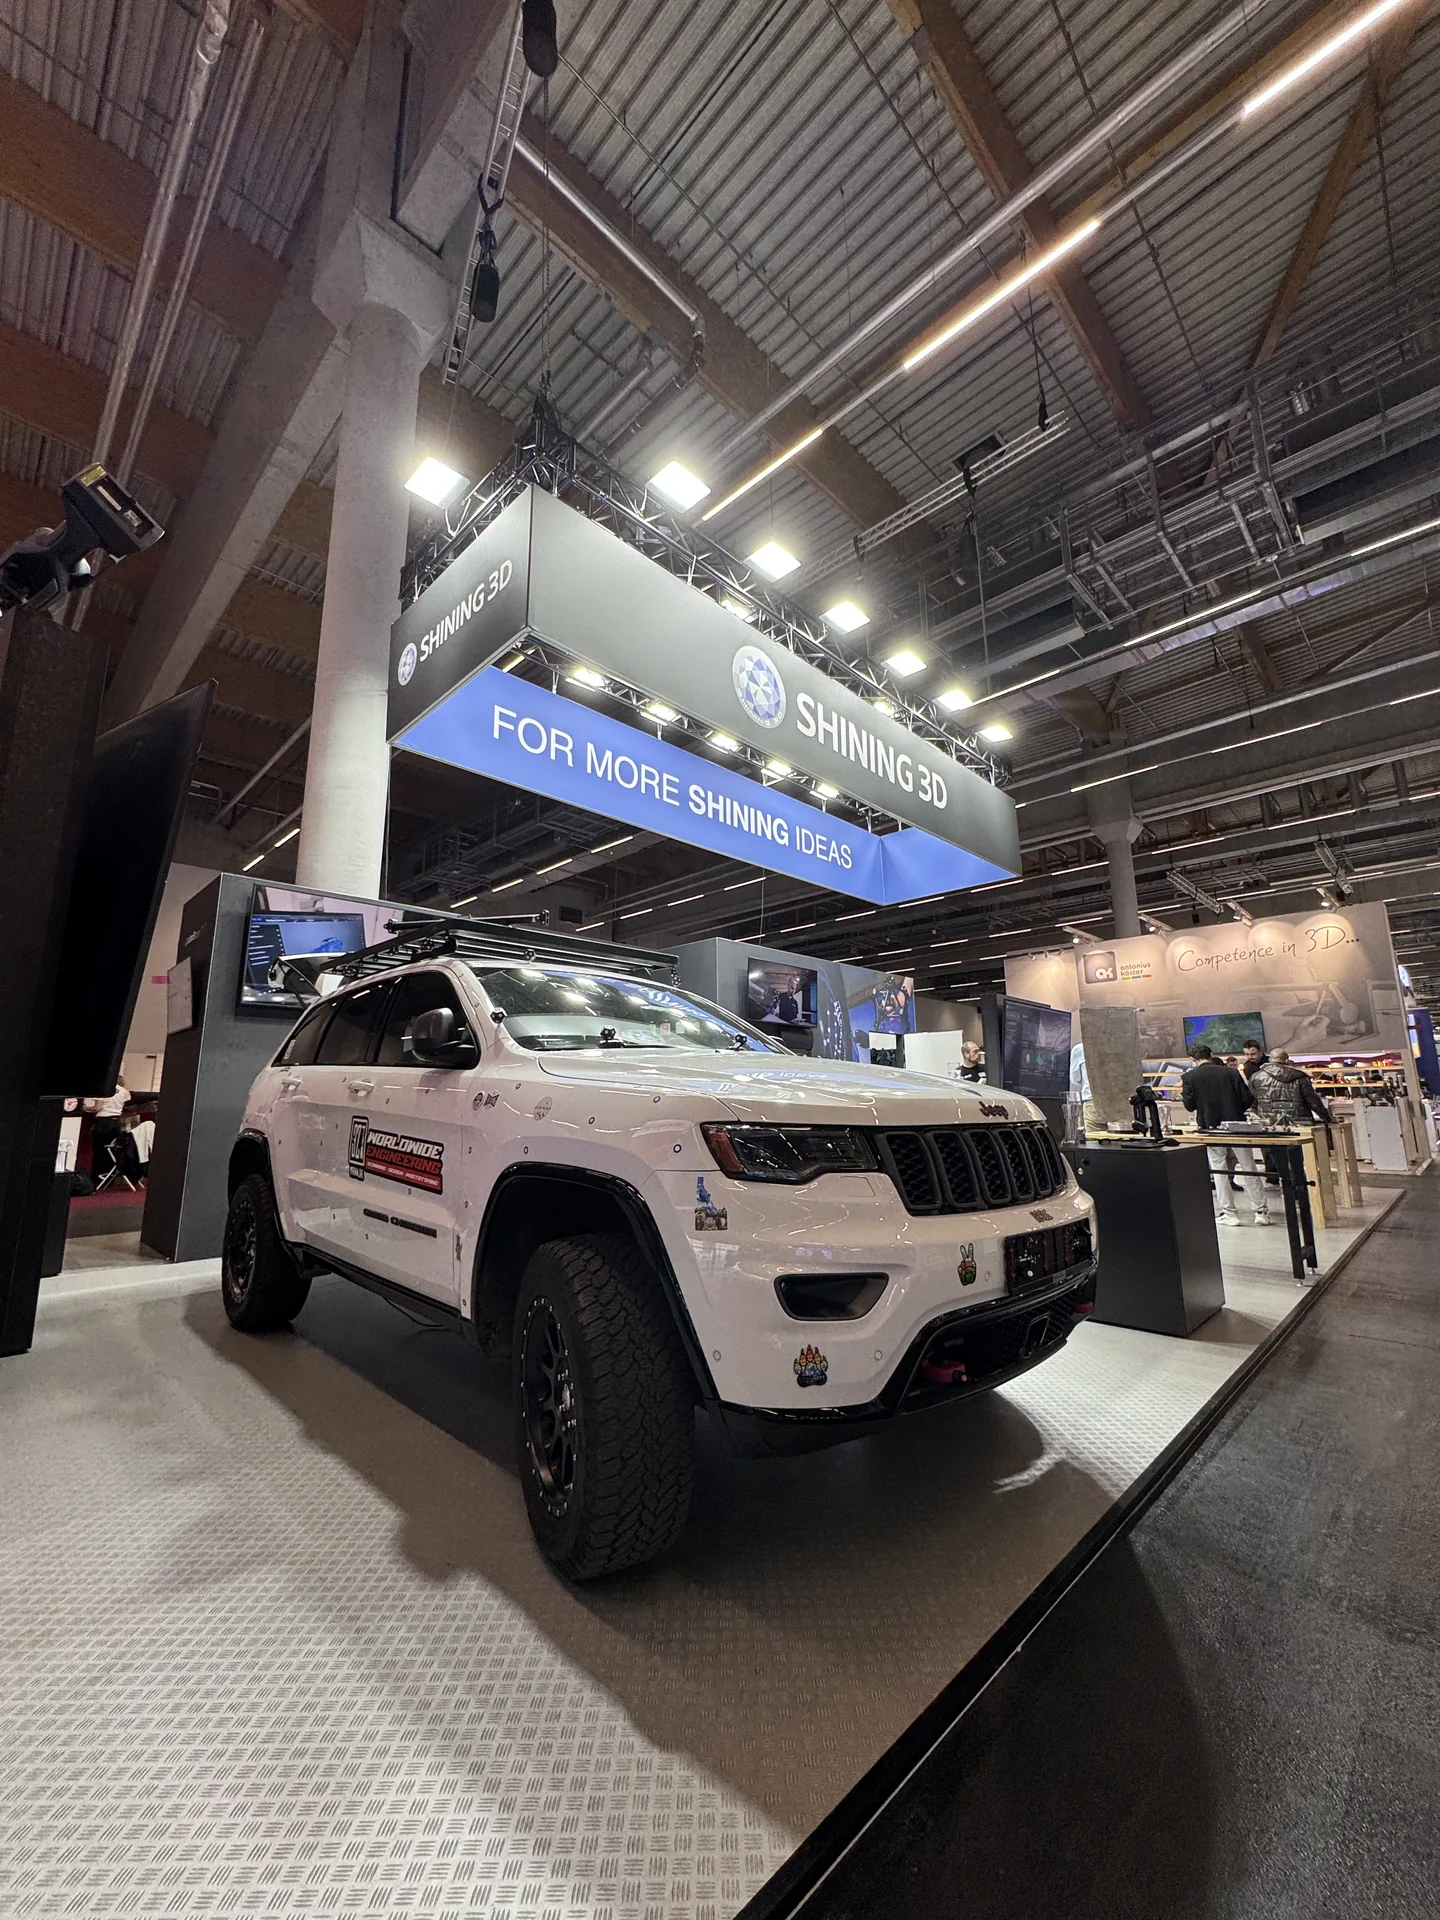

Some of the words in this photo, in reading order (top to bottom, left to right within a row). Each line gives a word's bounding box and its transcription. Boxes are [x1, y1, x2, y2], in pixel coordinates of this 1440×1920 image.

[419, 582, 486, 662] SHINING
[487, 559, 513, 602] 3D
[796, 692, 914, 793] SHINING
[918, 764, 948, 810] 3D
[493, 704, 575, 768] FOR
[586, 741, 680, 807] MORE
[688, 784, 789, 846] SHINING
[795, 825, 853, 870] IDEAS
[1120, 962, 1151, 970] antonius
[1178, 945, 1274, 971] Competence
[1282, 941, 1296, 956] in
[1120, 969, 1144, 977] köster
[978, 1100, 1009, 1120] Jeep
[366, 1146, 442, 1174] ENGINEERING
[367, 1131, 443, 1160] WORLDWIDE
